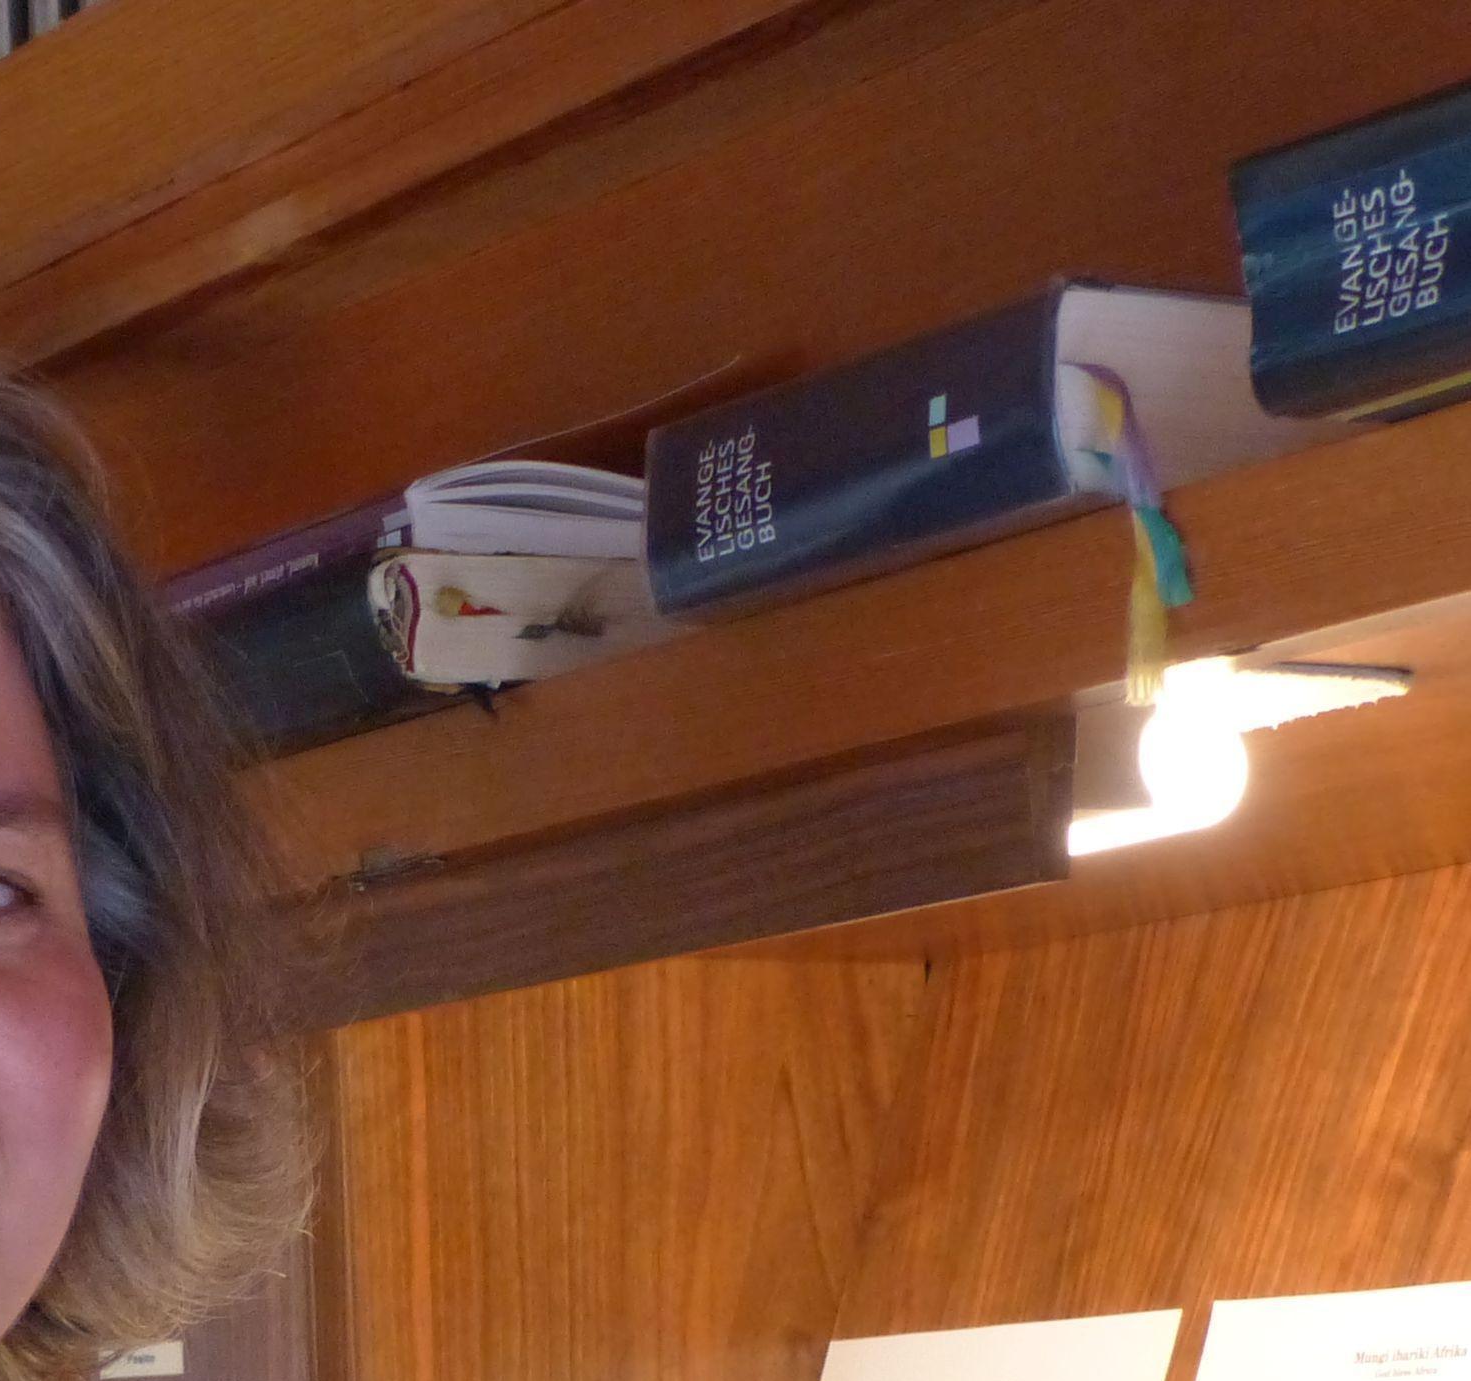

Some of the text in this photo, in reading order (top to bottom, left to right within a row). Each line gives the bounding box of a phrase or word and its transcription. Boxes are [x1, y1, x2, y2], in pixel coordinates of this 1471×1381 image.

[1333, 188, 1364, 334] EVANGE-
[1361, 187, 1392, 326] LISCHES
[1389, 168, 1420, 317] GESANG-
[1416, 212, 1448, 309] BUCH
[696, 439, 716, 562] EVANGE-
[715, 438, 735, 556] LISCHES
[735, 424, 755, 550] GESANG-
[756, 461, 776, 543] BUCH
